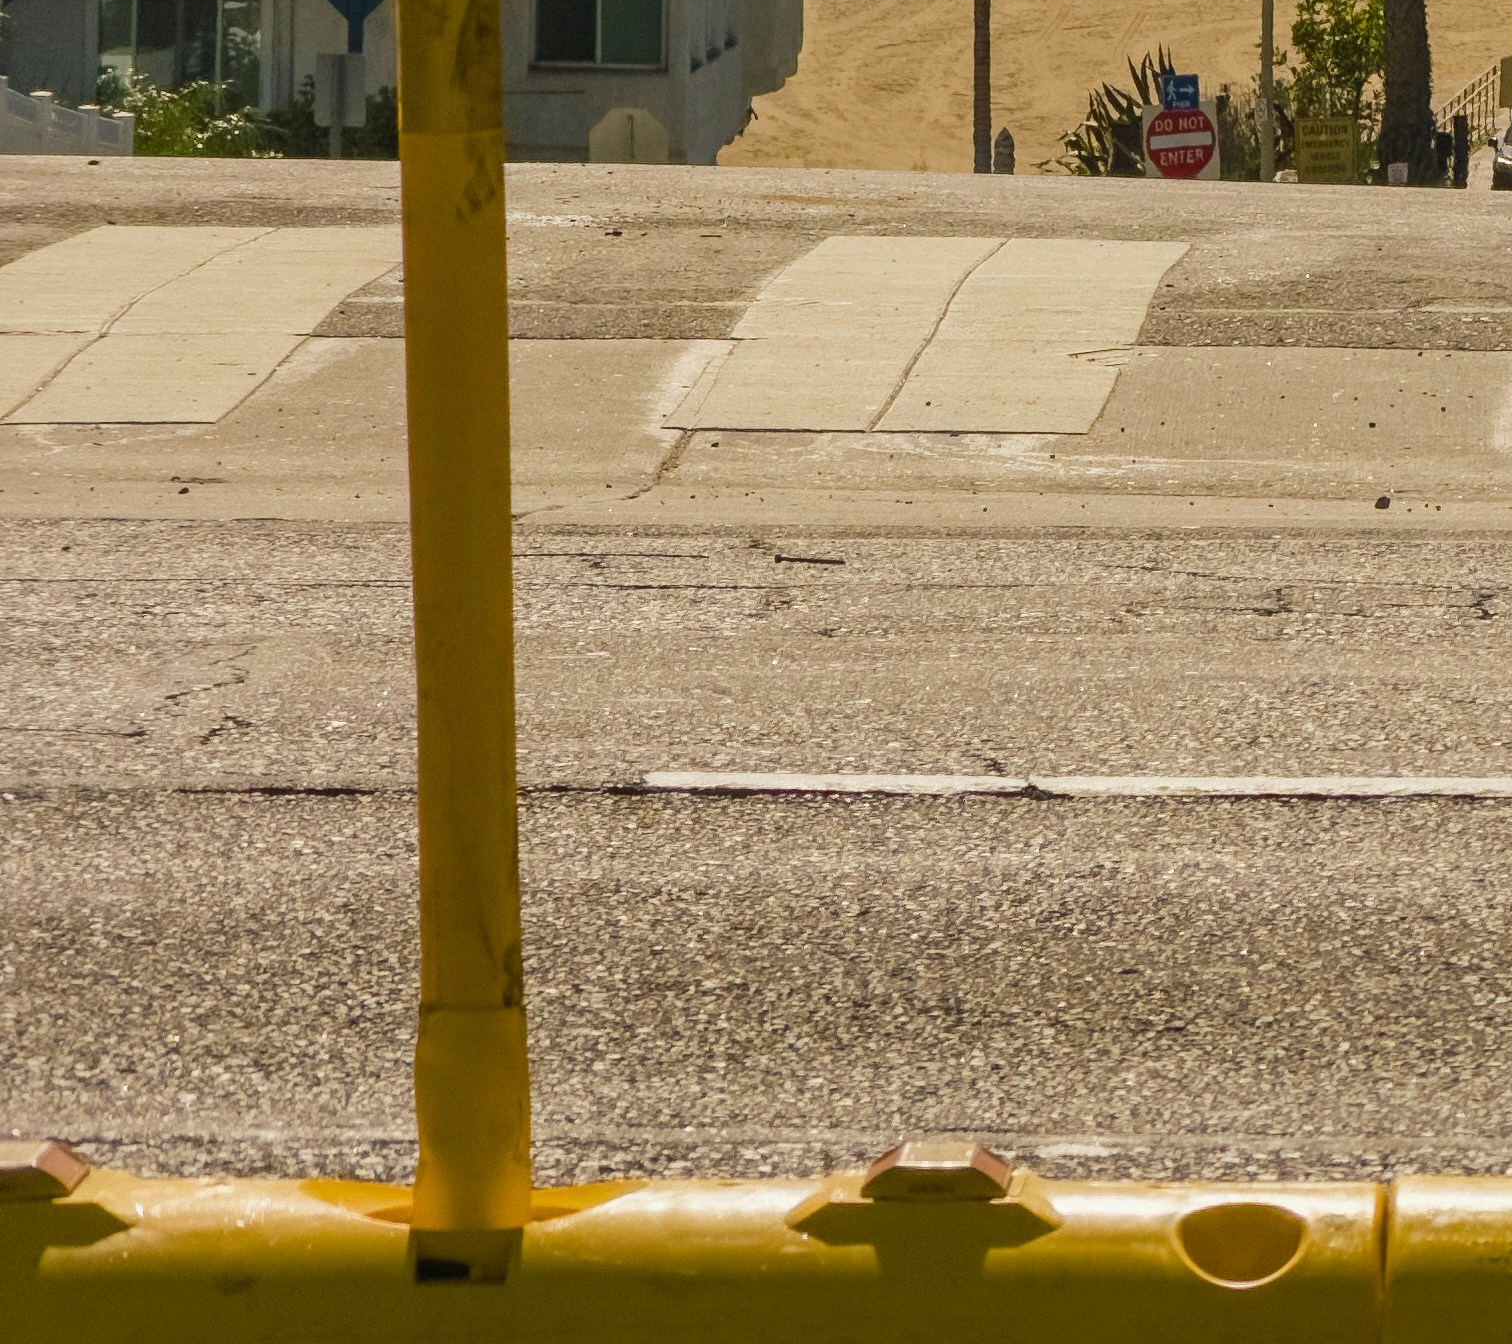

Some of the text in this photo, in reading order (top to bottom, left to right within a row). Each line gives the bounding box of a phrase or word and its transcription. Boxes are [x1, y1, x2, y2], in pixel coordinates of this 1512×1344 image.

[1172, 101, 1191, 109] PIER
[1155, 116, 1205, 132] DO NOT
[1302, 124, 1348, 136] CAUTION
[1160, 148, 1204, 166] ENTER
